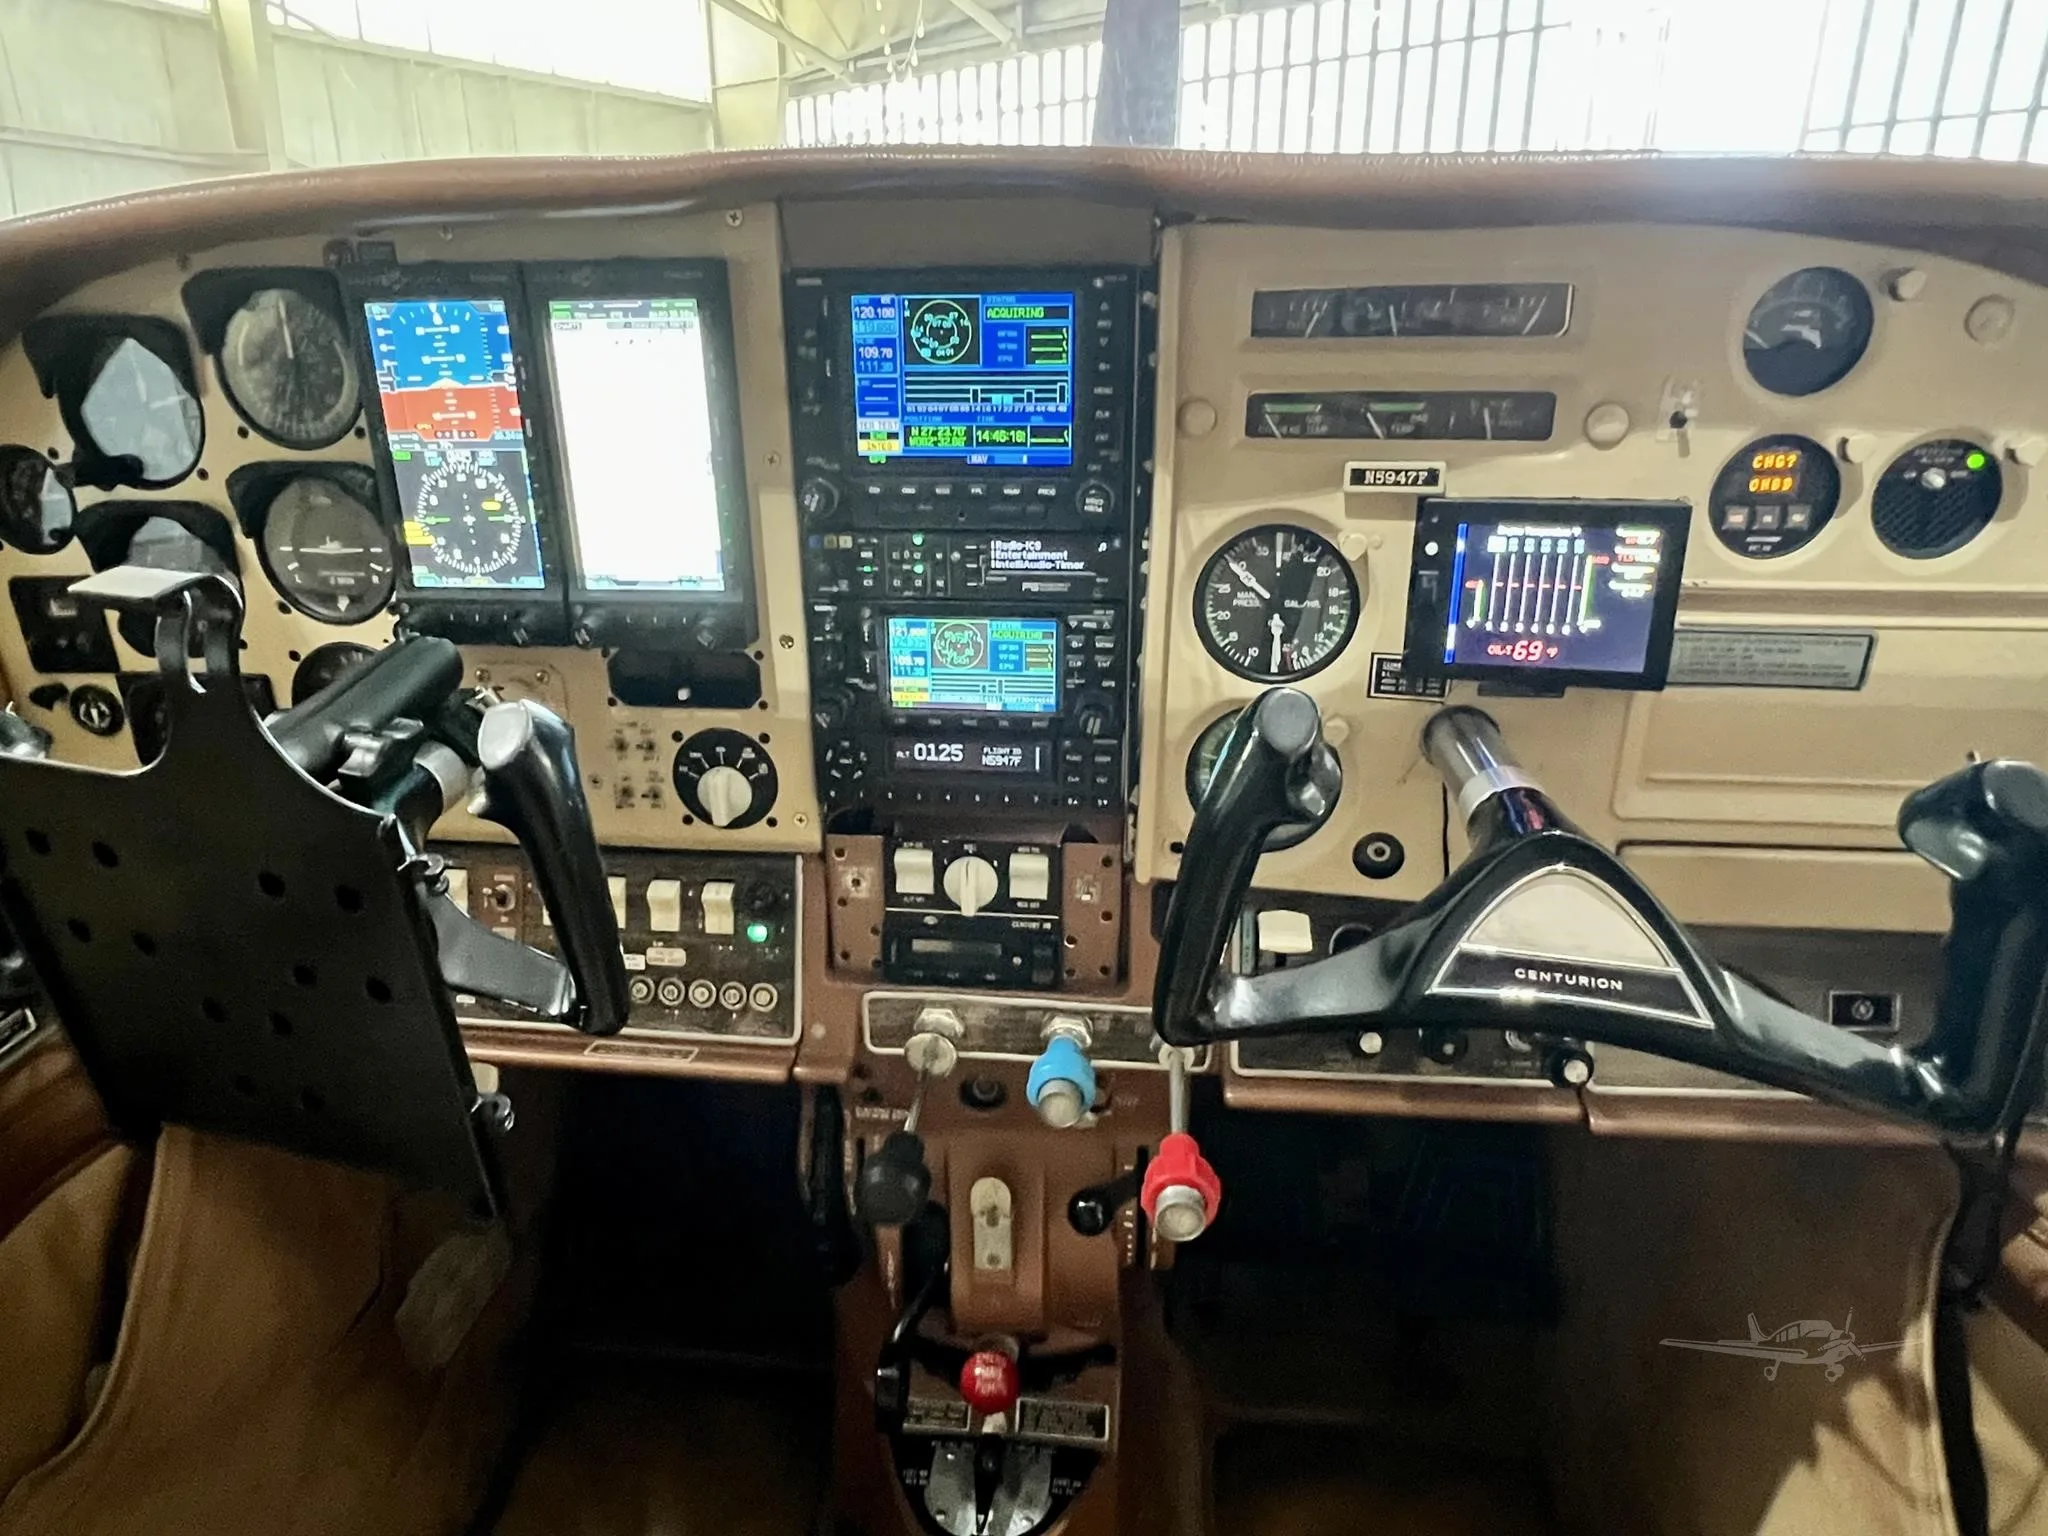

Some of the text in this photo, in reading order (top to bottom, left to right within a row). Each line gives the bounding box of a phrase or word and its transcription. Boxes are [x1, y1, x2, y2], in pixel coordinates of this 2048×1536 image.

[986, 307, 1044, 319] ACQUIRING
[1364, 470, 1428, 485] N5947F
[995, 550, 1068, 560] Entertainment
[1316, 566, 1331, 577] 20
[1216, 610, 1231, 621] 20
[1323, 621, 1333, 631] 14
[1314, 632, 1325, 643] 12
[1248, 647, 1260, 657] 10
[1512, 640, 1544, 662] 69
[914, 743, 964, 762] 0125
[982, 755, 1022, 766] N5947F
[1514, 967, 1623, 991] CENTURION
